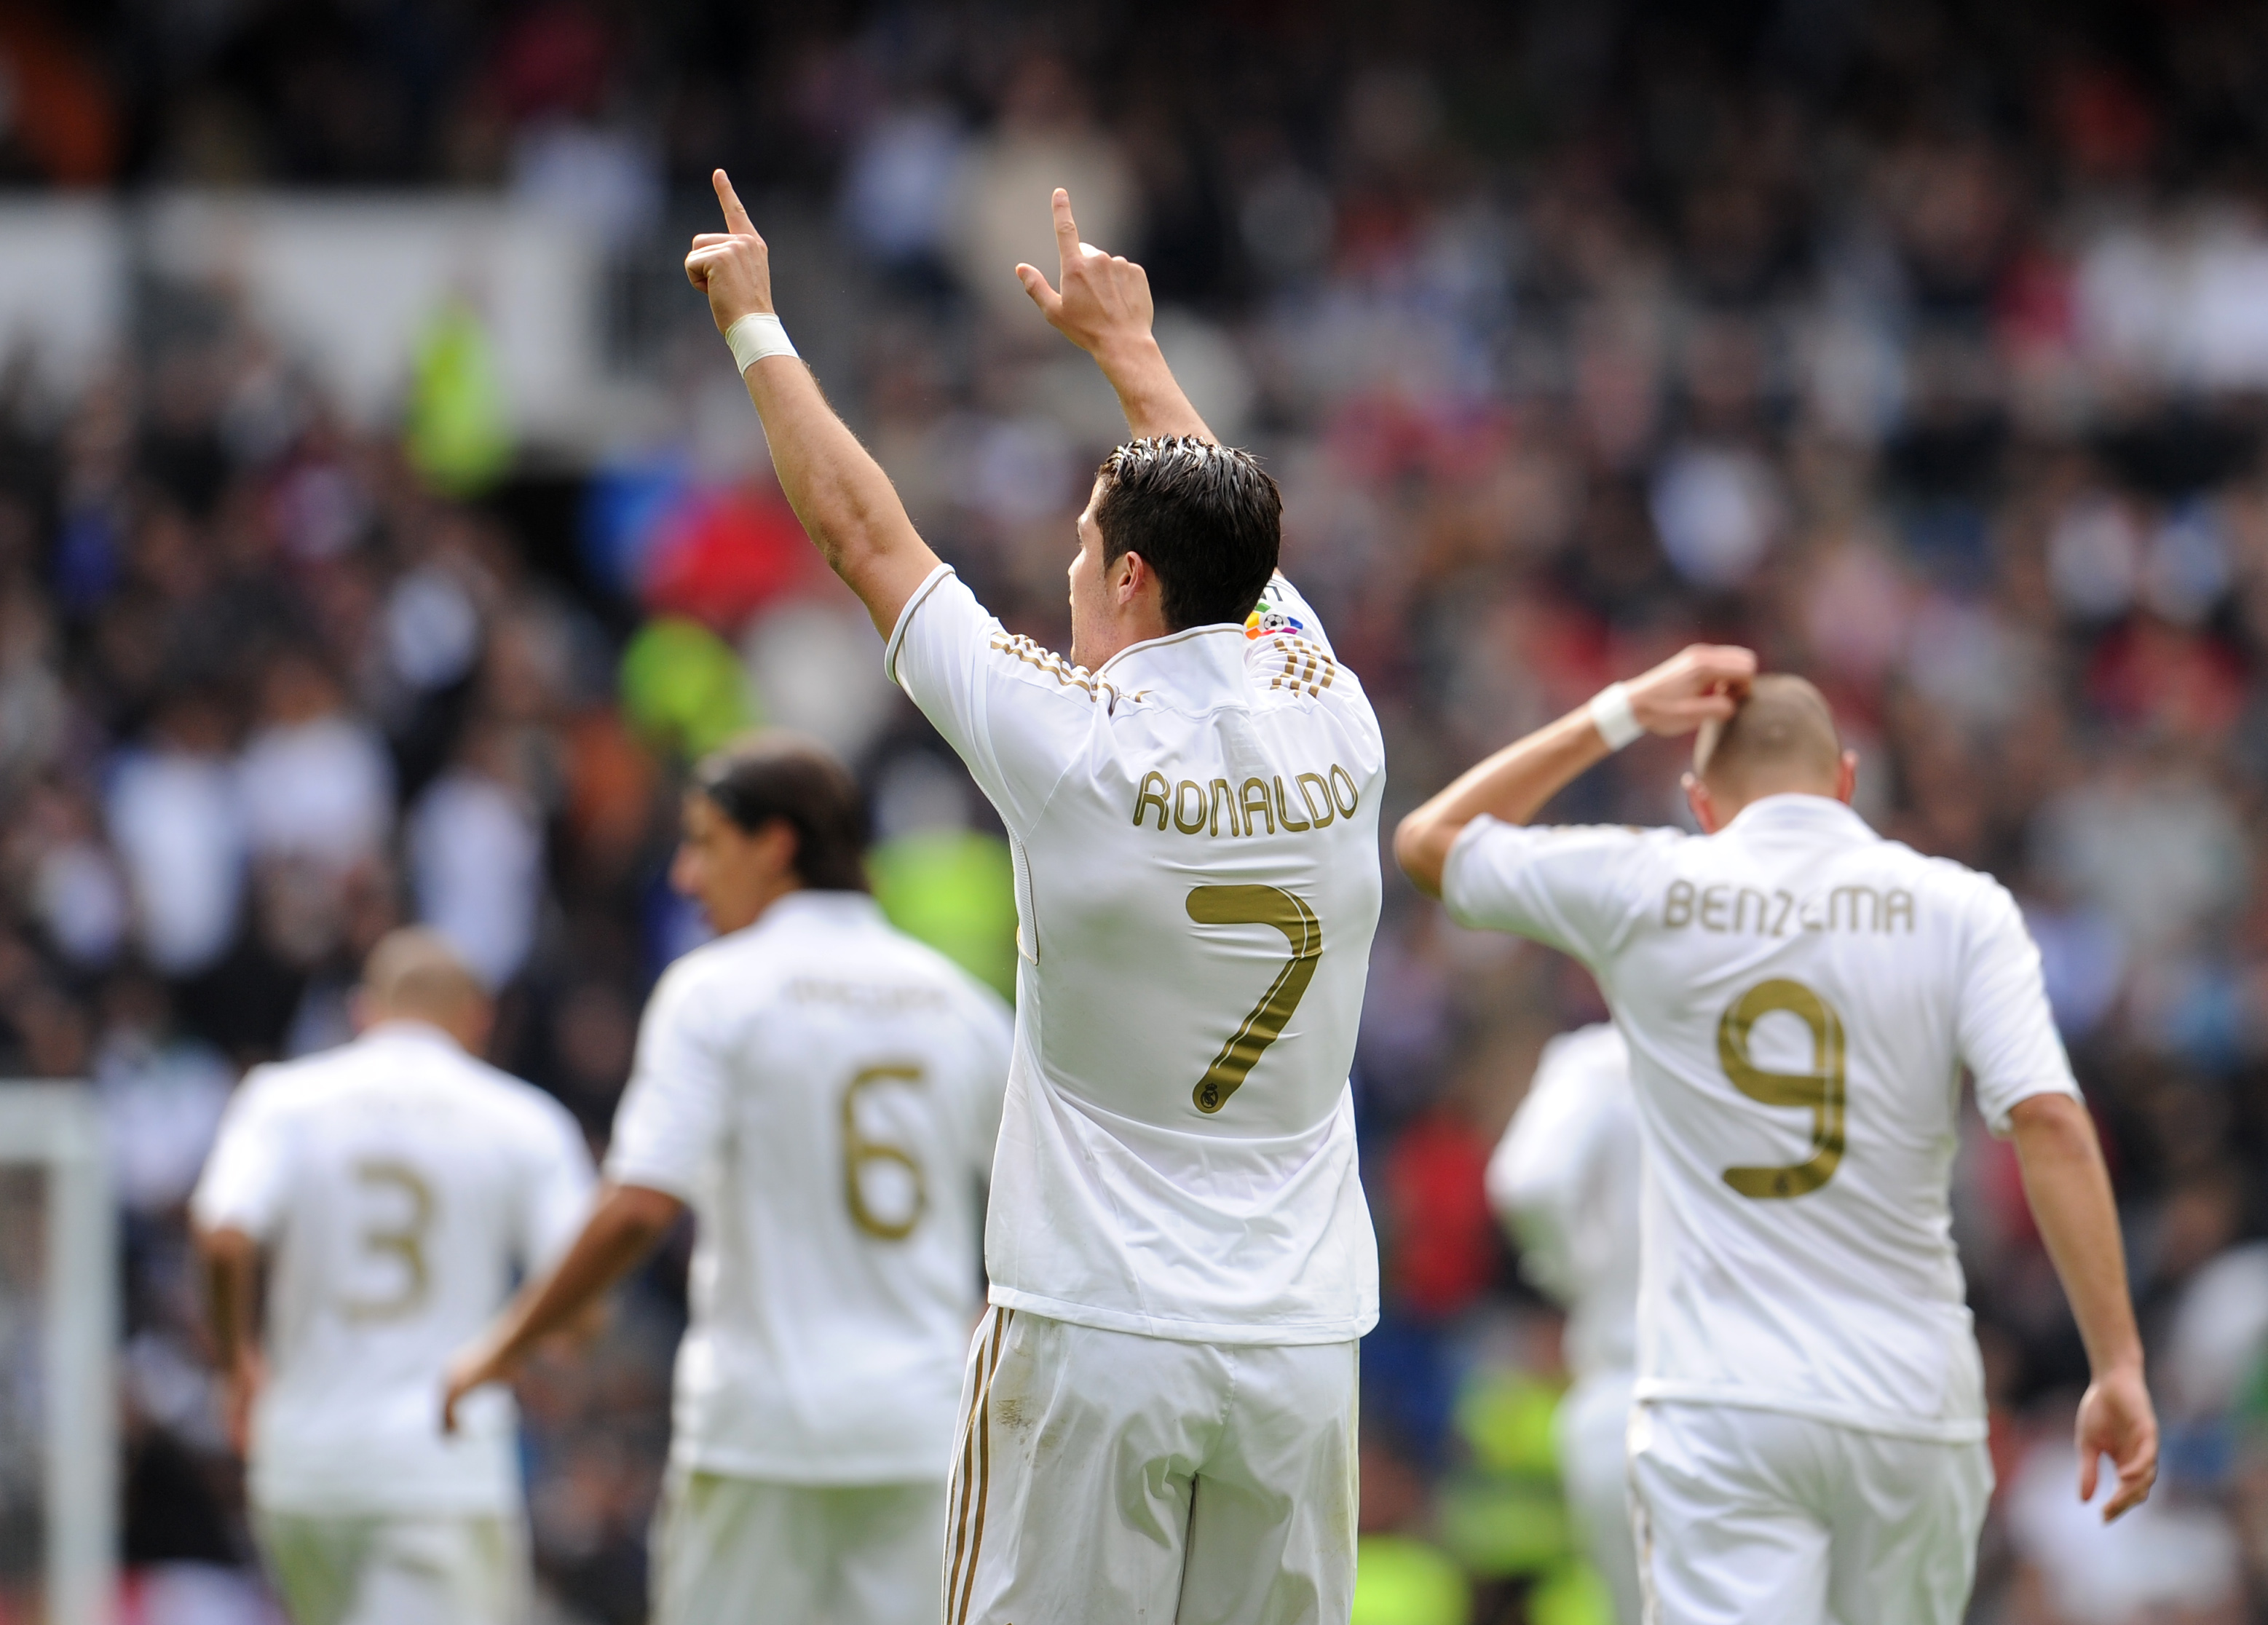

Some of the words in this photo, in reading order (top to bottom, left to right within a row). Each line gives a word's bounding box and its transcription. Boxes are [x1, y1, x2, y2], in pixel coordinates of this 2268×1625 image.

[1132, 763, 1359, 837] RONALDO
[1185, 884, 1323, 1114] 7
[839, 1063, 928, 1241] 6
[1717, 978, 1846, 1199] 9
[341, 1159, 437, 1324] 3
